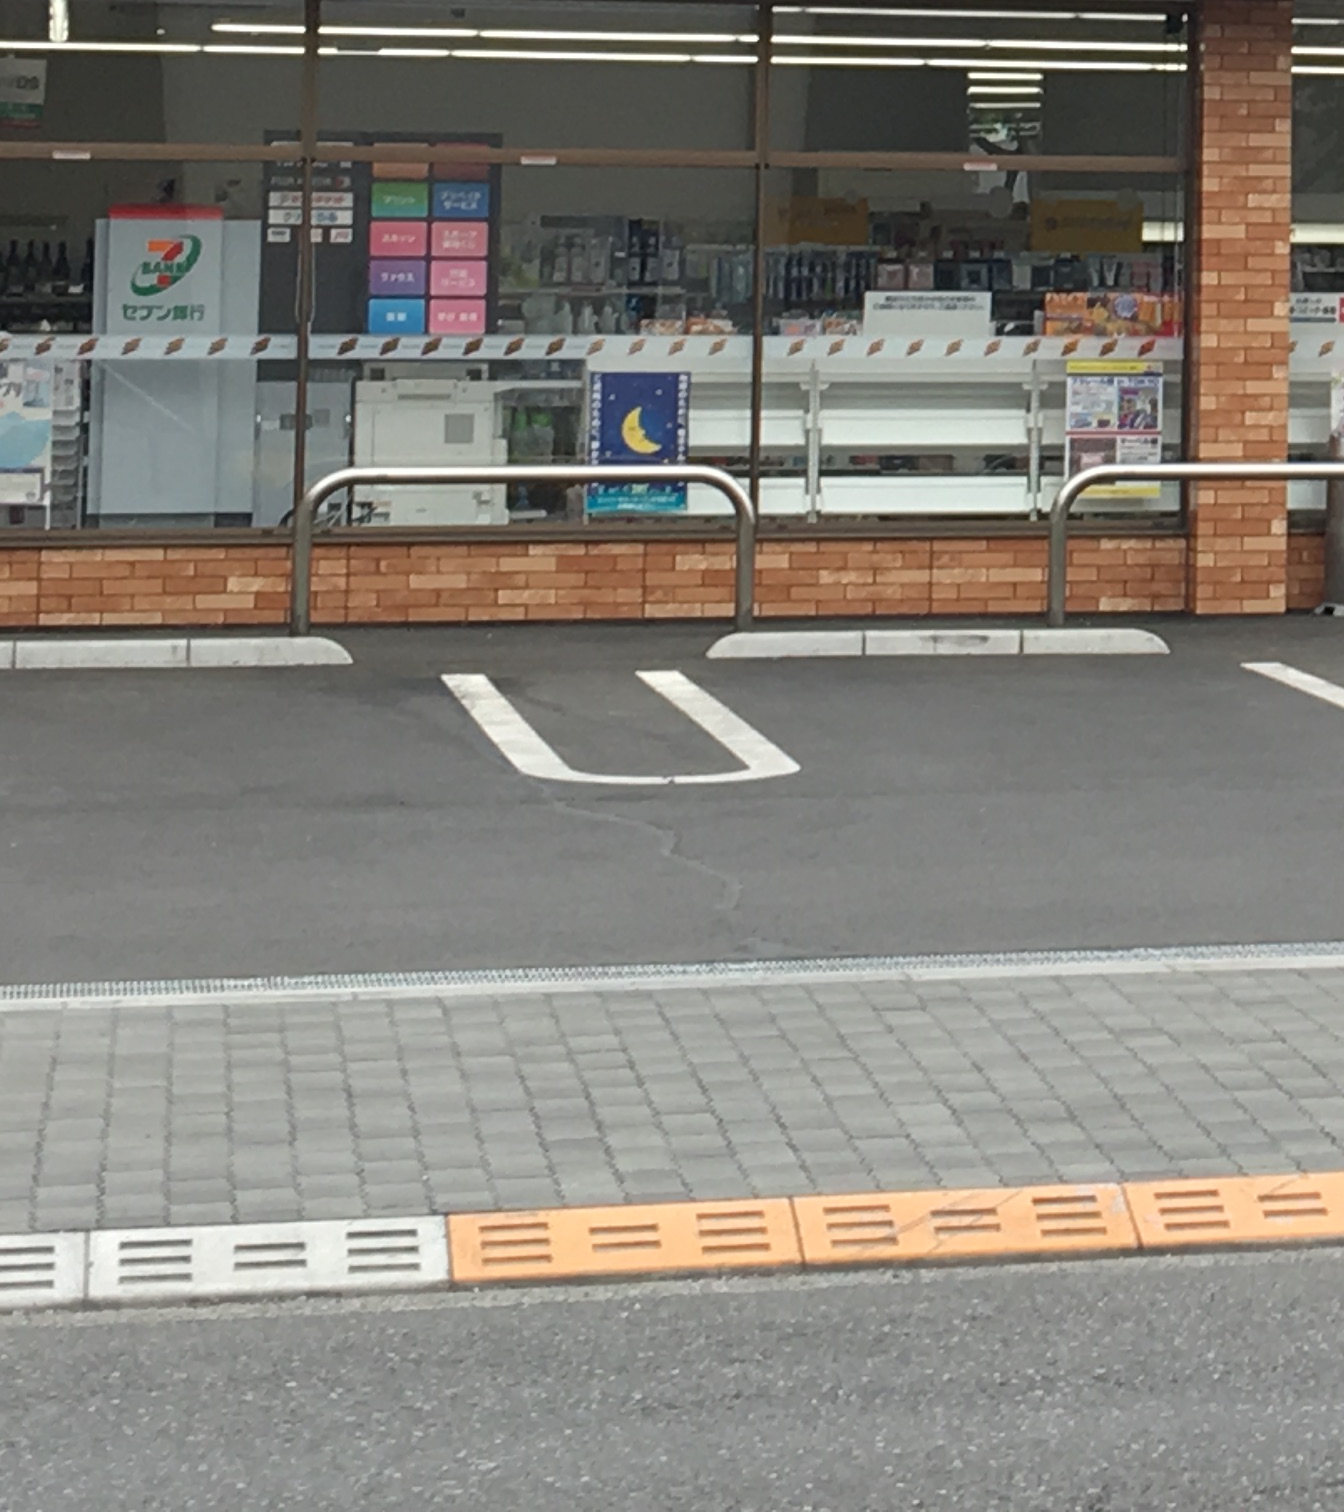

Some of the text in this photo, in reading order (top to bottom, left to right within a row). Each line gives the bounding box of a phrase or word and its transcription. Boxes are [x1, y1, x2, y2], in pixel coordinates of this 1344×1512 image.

[122, 304, 205, 321] セブン銀行
